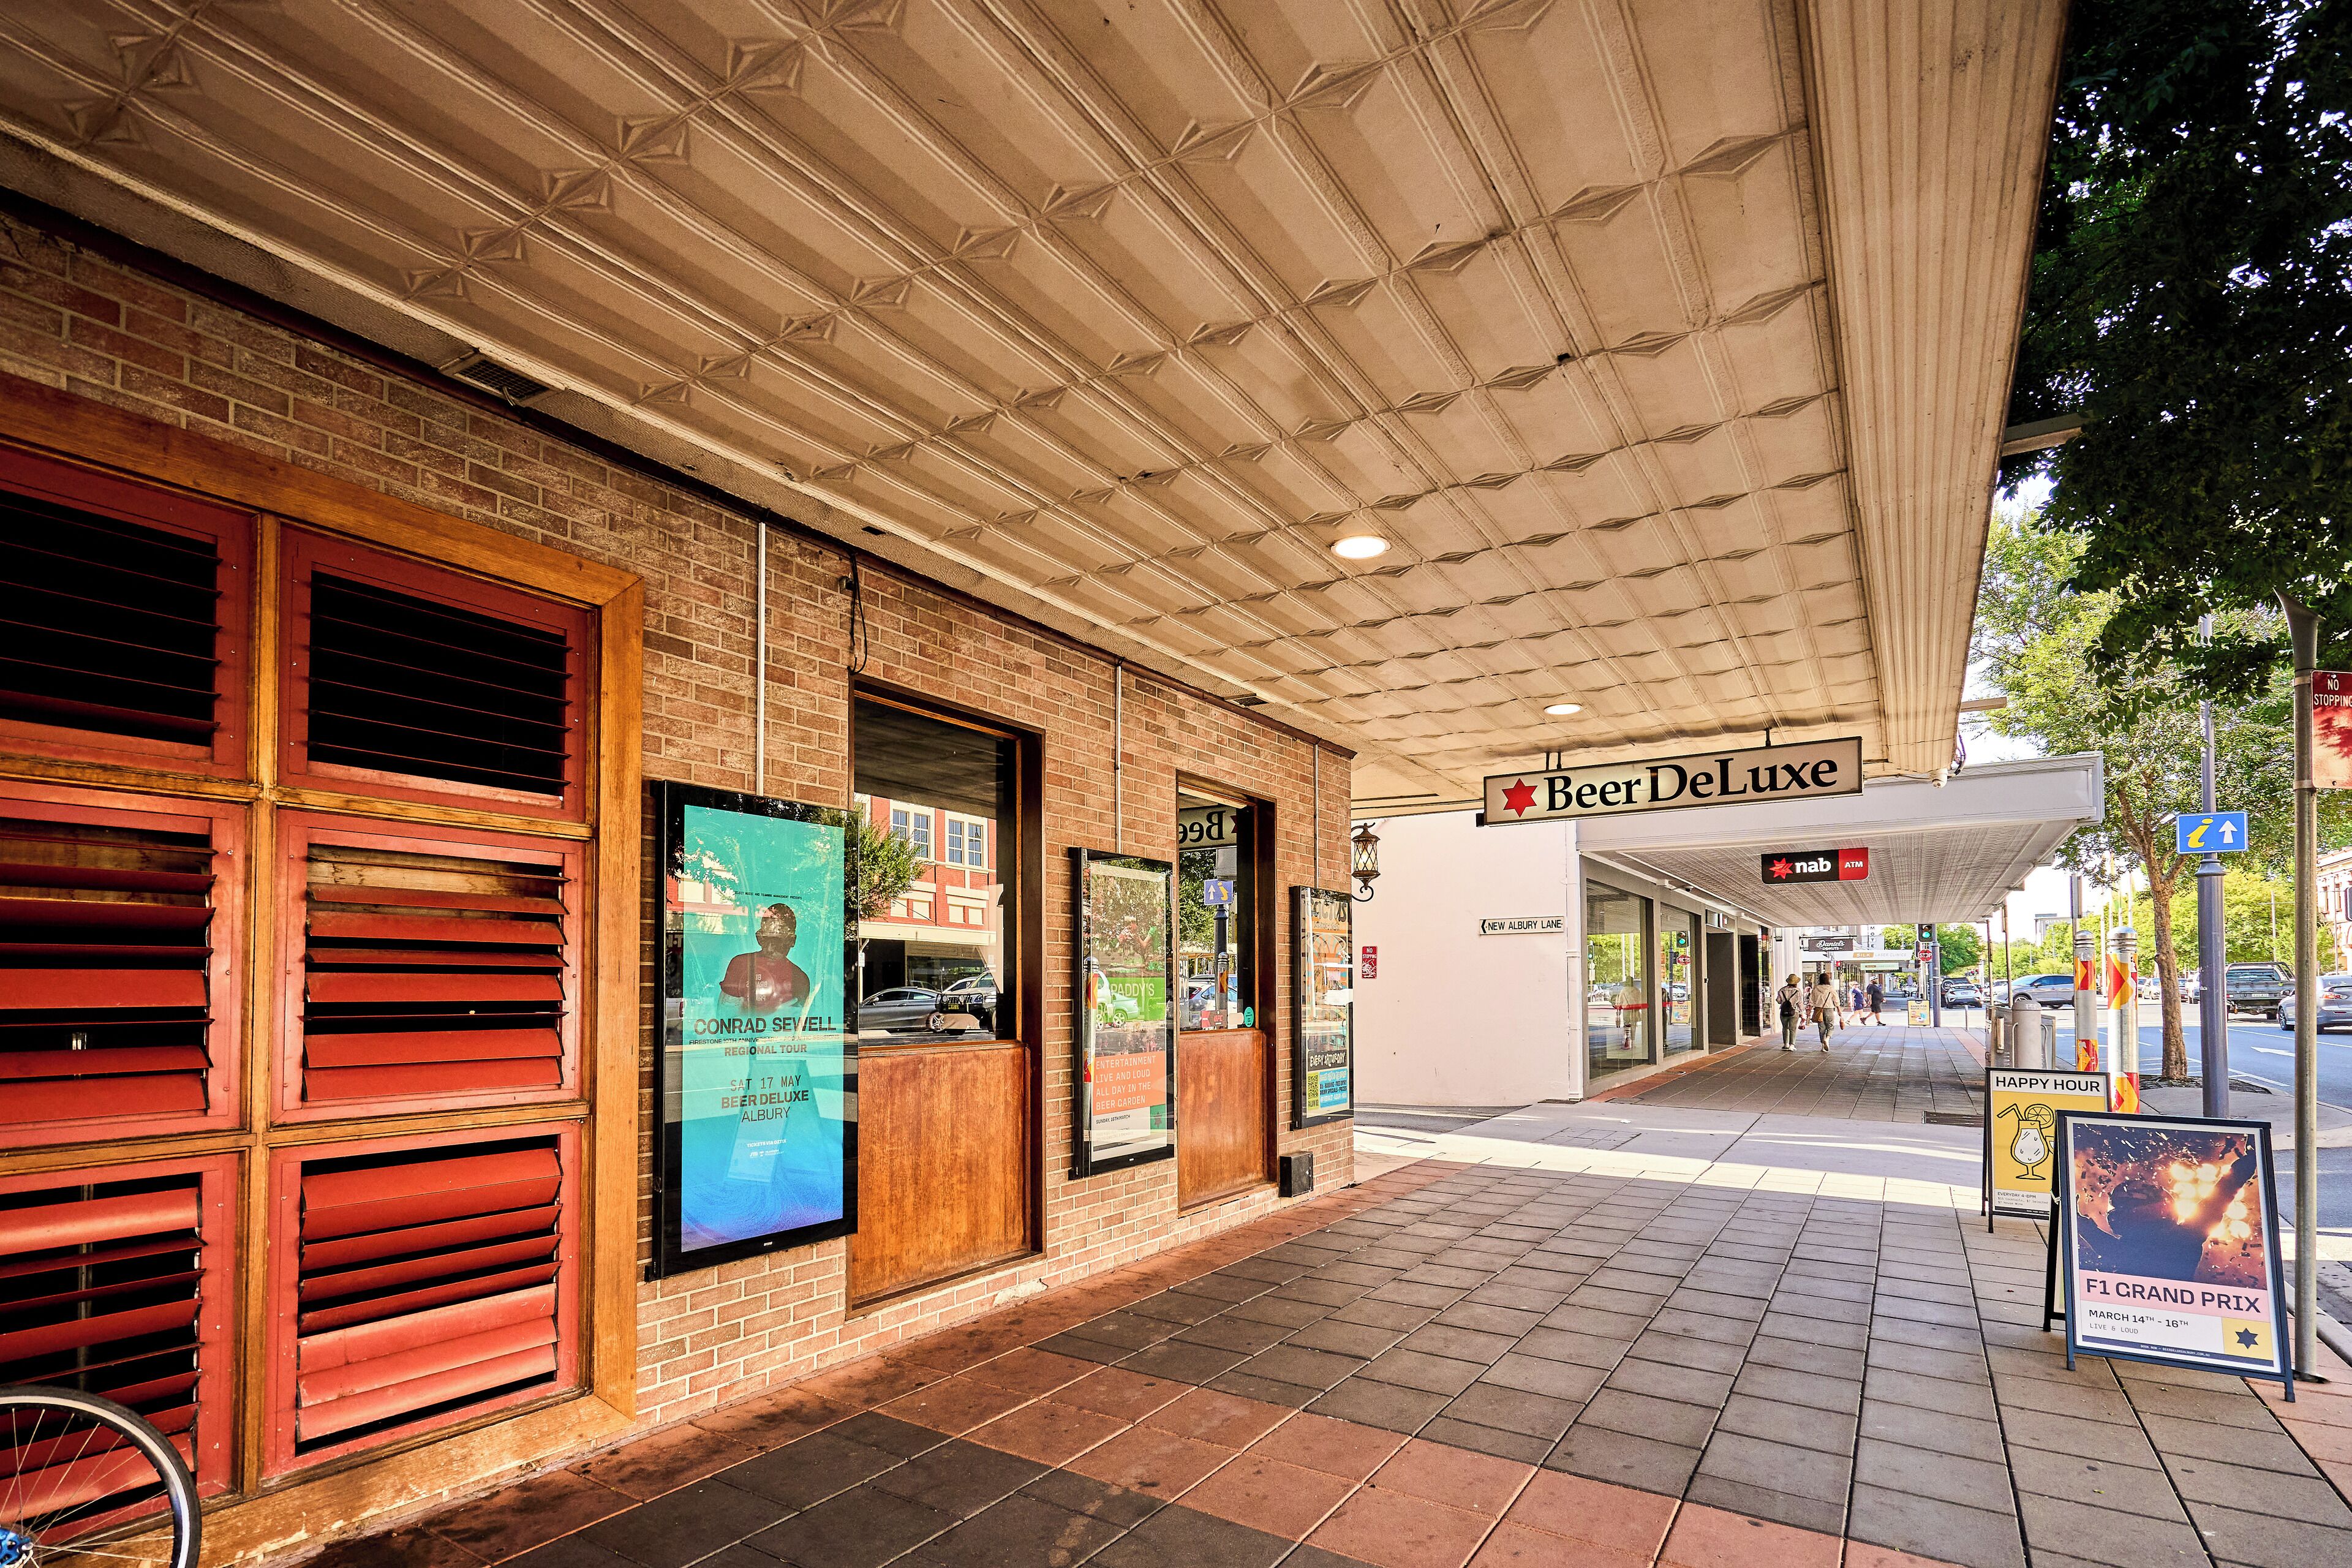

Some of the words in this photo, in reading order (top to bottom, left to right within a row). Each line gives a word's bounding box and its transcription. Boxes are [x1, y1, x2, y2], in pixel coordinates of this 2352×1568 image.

[2328, 679, 2339, 691] NO
[1544, 775, 1641, 811] Beer
[1646, 757, 1838, 804] DeLuxe
[1795, 858, 1831, 873] nab
[1488, 922, 1505, 931] NEW
[1509, 921, 1537, 930] ALBURY
[1541, 919, 1562, 929] LANE
[1111, 983, 1155, 997] PADDY'S
[694, 1017, 766, 1035] CONRAD
[772, 1016, 836, 1032] SEWELL
[725, 1045, 777, 1057] REGIONAL
[780, 1044, 807, 1053] TOUR
[1096, 1055, 1156, 1069] ENTERTAINMENT
[1310, 1054, 1324, 1067] EVERY
[1324, 1052, 1345, 1067] SATURDAY
[730, 1079, 752, 1091] SAT
[761, 1077, 774, 1089] 17
[781, 1074, 801, 1088] MAY
[1096, 1073, 1113, 1084] LIVE
[1116, 1071, 1131, 1080] AND
[1133, 1069, 1150, 1079] LOUD
[1096, 1088, 1109, 1098] ALL
[1112, 1085, 1126, 1095] DAY
[1128, 1084, 1136, 1092] IN
[1138, 1082, 1152, 1090] THE
[1996, 1076, 2049, 1090] HAPPY
[2053, 1078, 2100, 1093] HOUR
[722, 1095, 757, 1109] BEER
[760, 1090, 809, 1105] DELUXE
[1096, 1100, 1115, 1110] BEER
[1118, 1095, 1145, 1107] GARDEN
[741, 1106, 791, 1122] ALBURY
[2086, 1278, 2111, 1295] F1
[2116, 1282, 2195, 1306] GRAND
[2201, 1292, 2262, 1313] PRIX
[2089, 1310, 2129, 1322] MARCH
[2132, 1315, 2154, 1324] 14TH
[2165, 1319, 2188, 1328] 16TH
